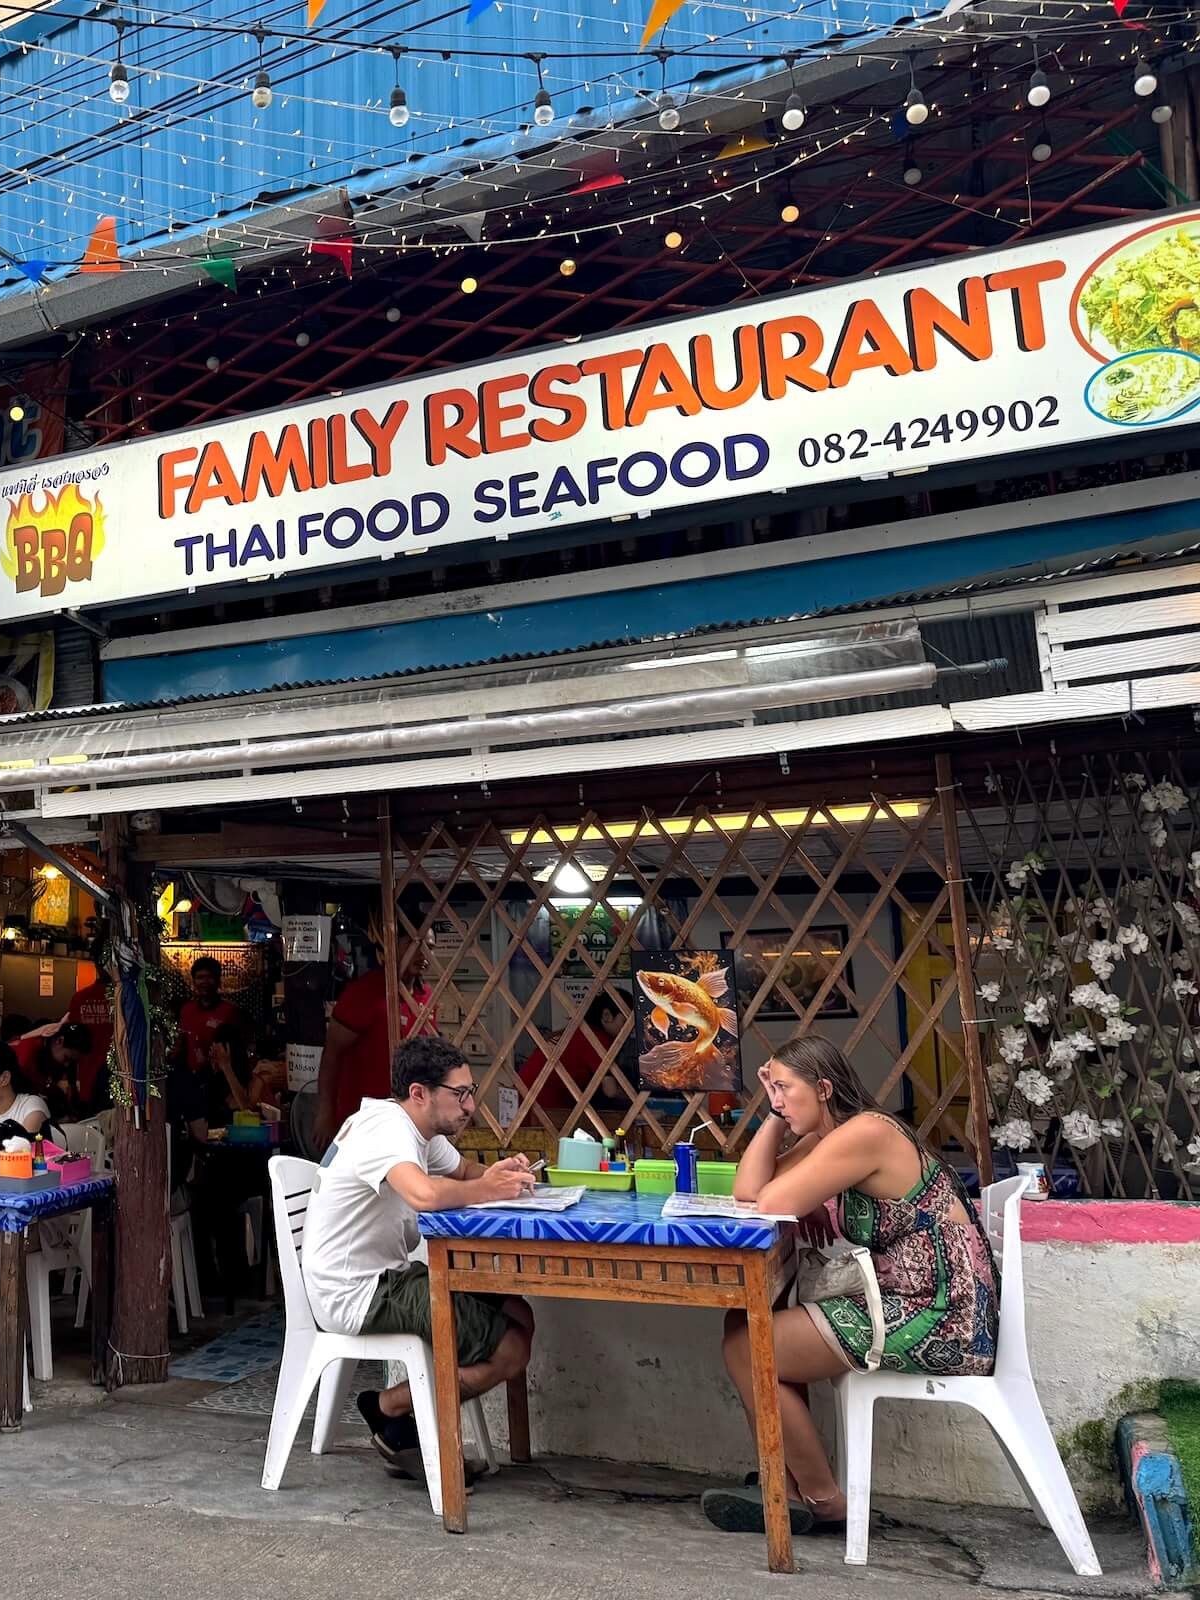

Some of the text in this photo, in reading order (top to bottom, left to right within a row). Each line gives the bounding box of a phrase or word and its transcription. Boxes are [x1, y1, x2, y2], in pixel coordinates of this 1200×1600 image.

[156, 401, 408, 518] FAMILY
[423, 261, 1065, 464] RESTAURANT
[798, 395, 1061, 468] 082-4249902
[13, 512, 94, 598] BBQ
[173, 433, 771, 577] THAI FOOD SEAFOOD
